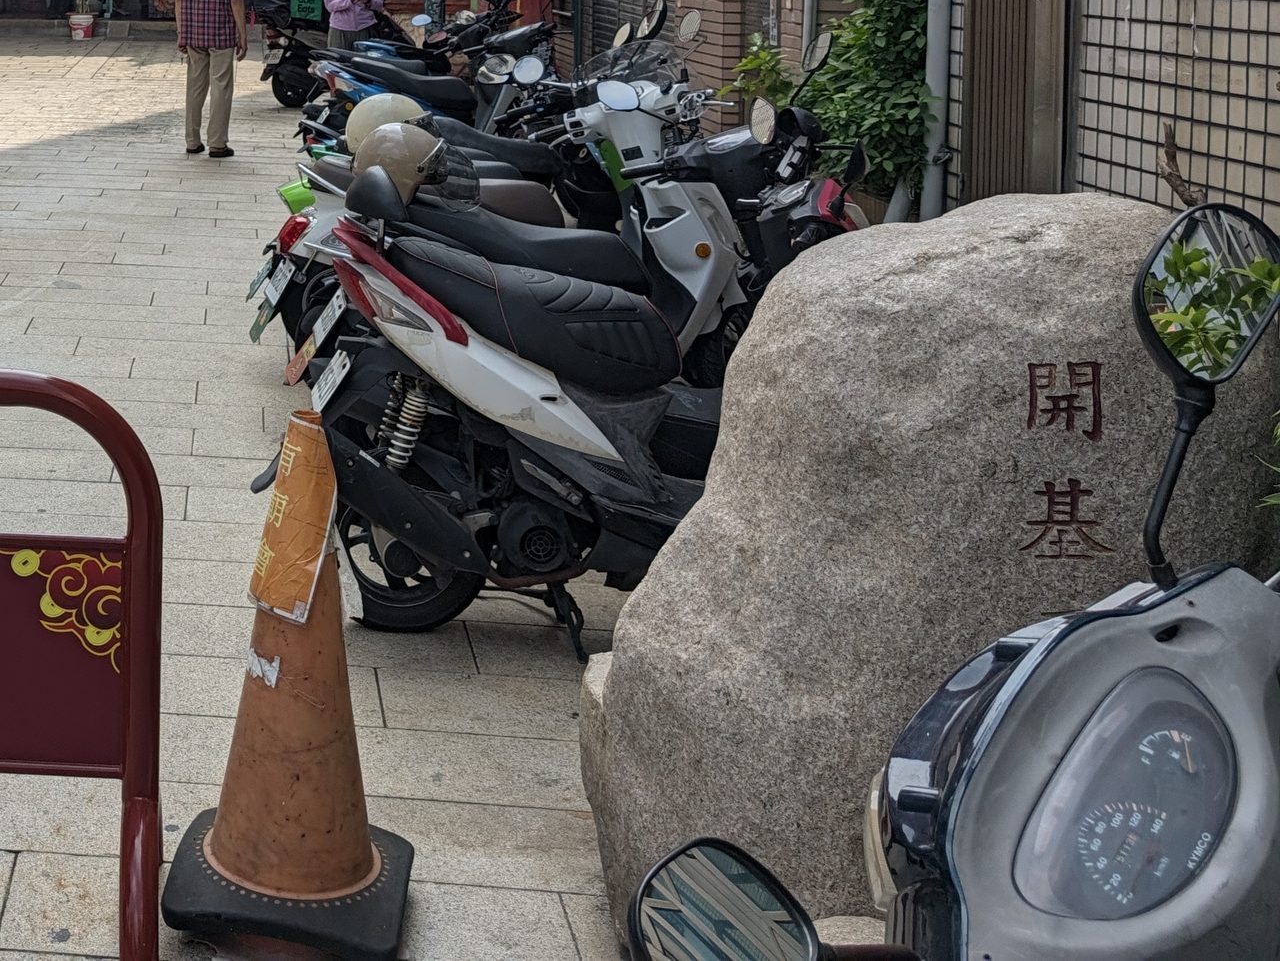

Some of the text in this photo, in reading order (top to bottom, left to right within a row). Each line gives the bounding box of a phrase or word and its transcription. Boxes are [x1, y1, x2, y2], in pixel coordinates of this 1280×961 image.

[297, 4, 316, 14] Eats
[1019, 360, 1114, 616] 開基
[1110, 812, 1124, 828] 100
[1128, 812, 1142, 828] 120
[1150, 818, 1164, 834] 140
[1094, 821, 1107, 835] 80
[1089, 837, 1102, 851] 60
[1186, 831, 1212, 870] KYMCO
[1096, 856, 1108, 870] 40
[1109, 873, 1122, 887] 20
